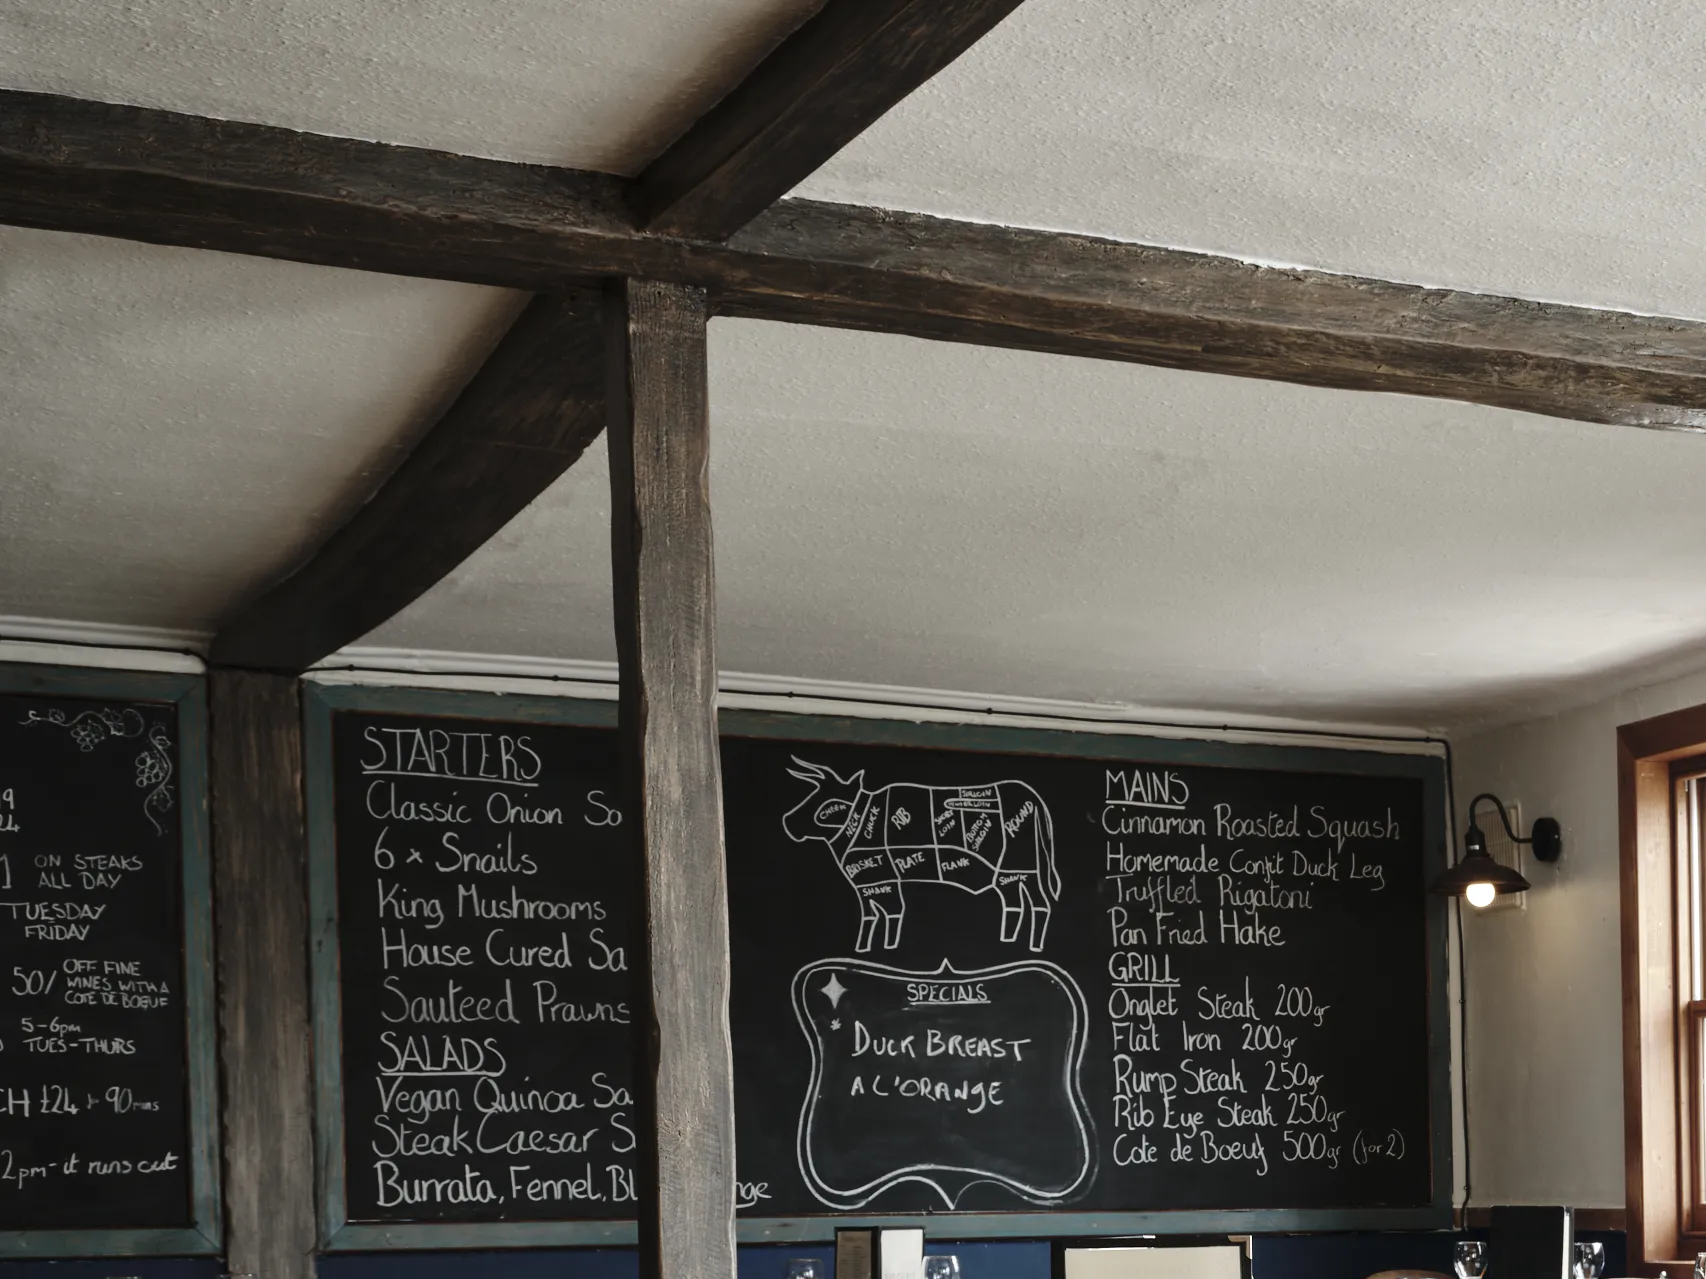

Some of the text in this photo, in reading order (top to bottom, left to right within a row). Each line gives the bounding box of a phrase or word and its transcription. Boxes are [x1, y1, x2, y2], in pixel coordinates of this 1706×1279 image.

[360, 726, 542, 781] STARTERS
[366, 780, 472, 823] Classic
[486, 792, 563, 824] Onion
[1105, 769, 1189, 804] MAINS
[819, 804, 847, 820] CHEEK
[844, 811, 861, 838] NECK
[864, 805, 881, 840] CHUCK
[891, 807, 912, 831] RIB
[938, 819, 956, 838] LOIN
[965, 812, 989, 844] BOTTOM
[1003, 801, 1034, 838] ROUND
[1101, 803, 1400, 854] Cinnamon Roasted Squash
[34, 854, 61, 868] ON
[73, 854, 143, 871] STEAKS
[374, 826, 395, 869] 6
[435, 832, 538, 875] Snails
[845, 854, 884, 879] BRISKET
[895, 851, 926, 874] PLATE
[941, 857, 970, 873] FLANK
[1105, 841, 1385, 891] Homemade Confit Duck Leg
[38, 871, 122, 890] ALL DAY
[1105, 873, 1313, 915] Truffled Rigatoni
[0, 902, 107, 921] TUESDAY
[377, 878, 606, 929] King Mushrooms
[25, 924, 90, 941] FRIDAY
[1107, 906, 1286, 947] Pan Fried Hake
[381, 927, 474, 969] House
[486, 929, 572, 968] Cured
[63, 958, 98, 974] OFF
[103, 960, 141, 976] FINE
[66, 975, 112, 991] WINES
[118, 980, 158, 993] WITH
[1108, 952, 1181, 984] GRILL
[64, 990, 98, 1005] COTE
[100, 991, 119, 1006] DE
[381, 975, 631, 1024] Sauteed Prawns
[906, 983, 988, 1003] SPECIALS
[1108, 976, 1331, 1031] Onglet Steak 200gr
[377, 1031, 507, 1077] SALADS
[852, 1020, 1032, 1062] DUCK BREAST
[1111, 1020, 1298, 1058] Flat Iron 200gr
[1113, 1054, 1324, 1102] Rump Steak 250gr
[376, 1075, 462, 1124] Vegan
[474, 1076, 585, 1113] Quinoa
[1113, 1093, 1346, 1138] Rib Eye Steak 250gr
[372, 1114, 473, 1158] Steak
[476, 1111, 599, 1155] Caesar
[87, 1160, 133, 1175] runs
[1113, 1133, 1158, 1166] Cote
[1170, 1132, 1193, 1162] de
[1201, 1130, 1268, 1177] Boeuf
[1282, 1130, 1342, 1170] 500gr
